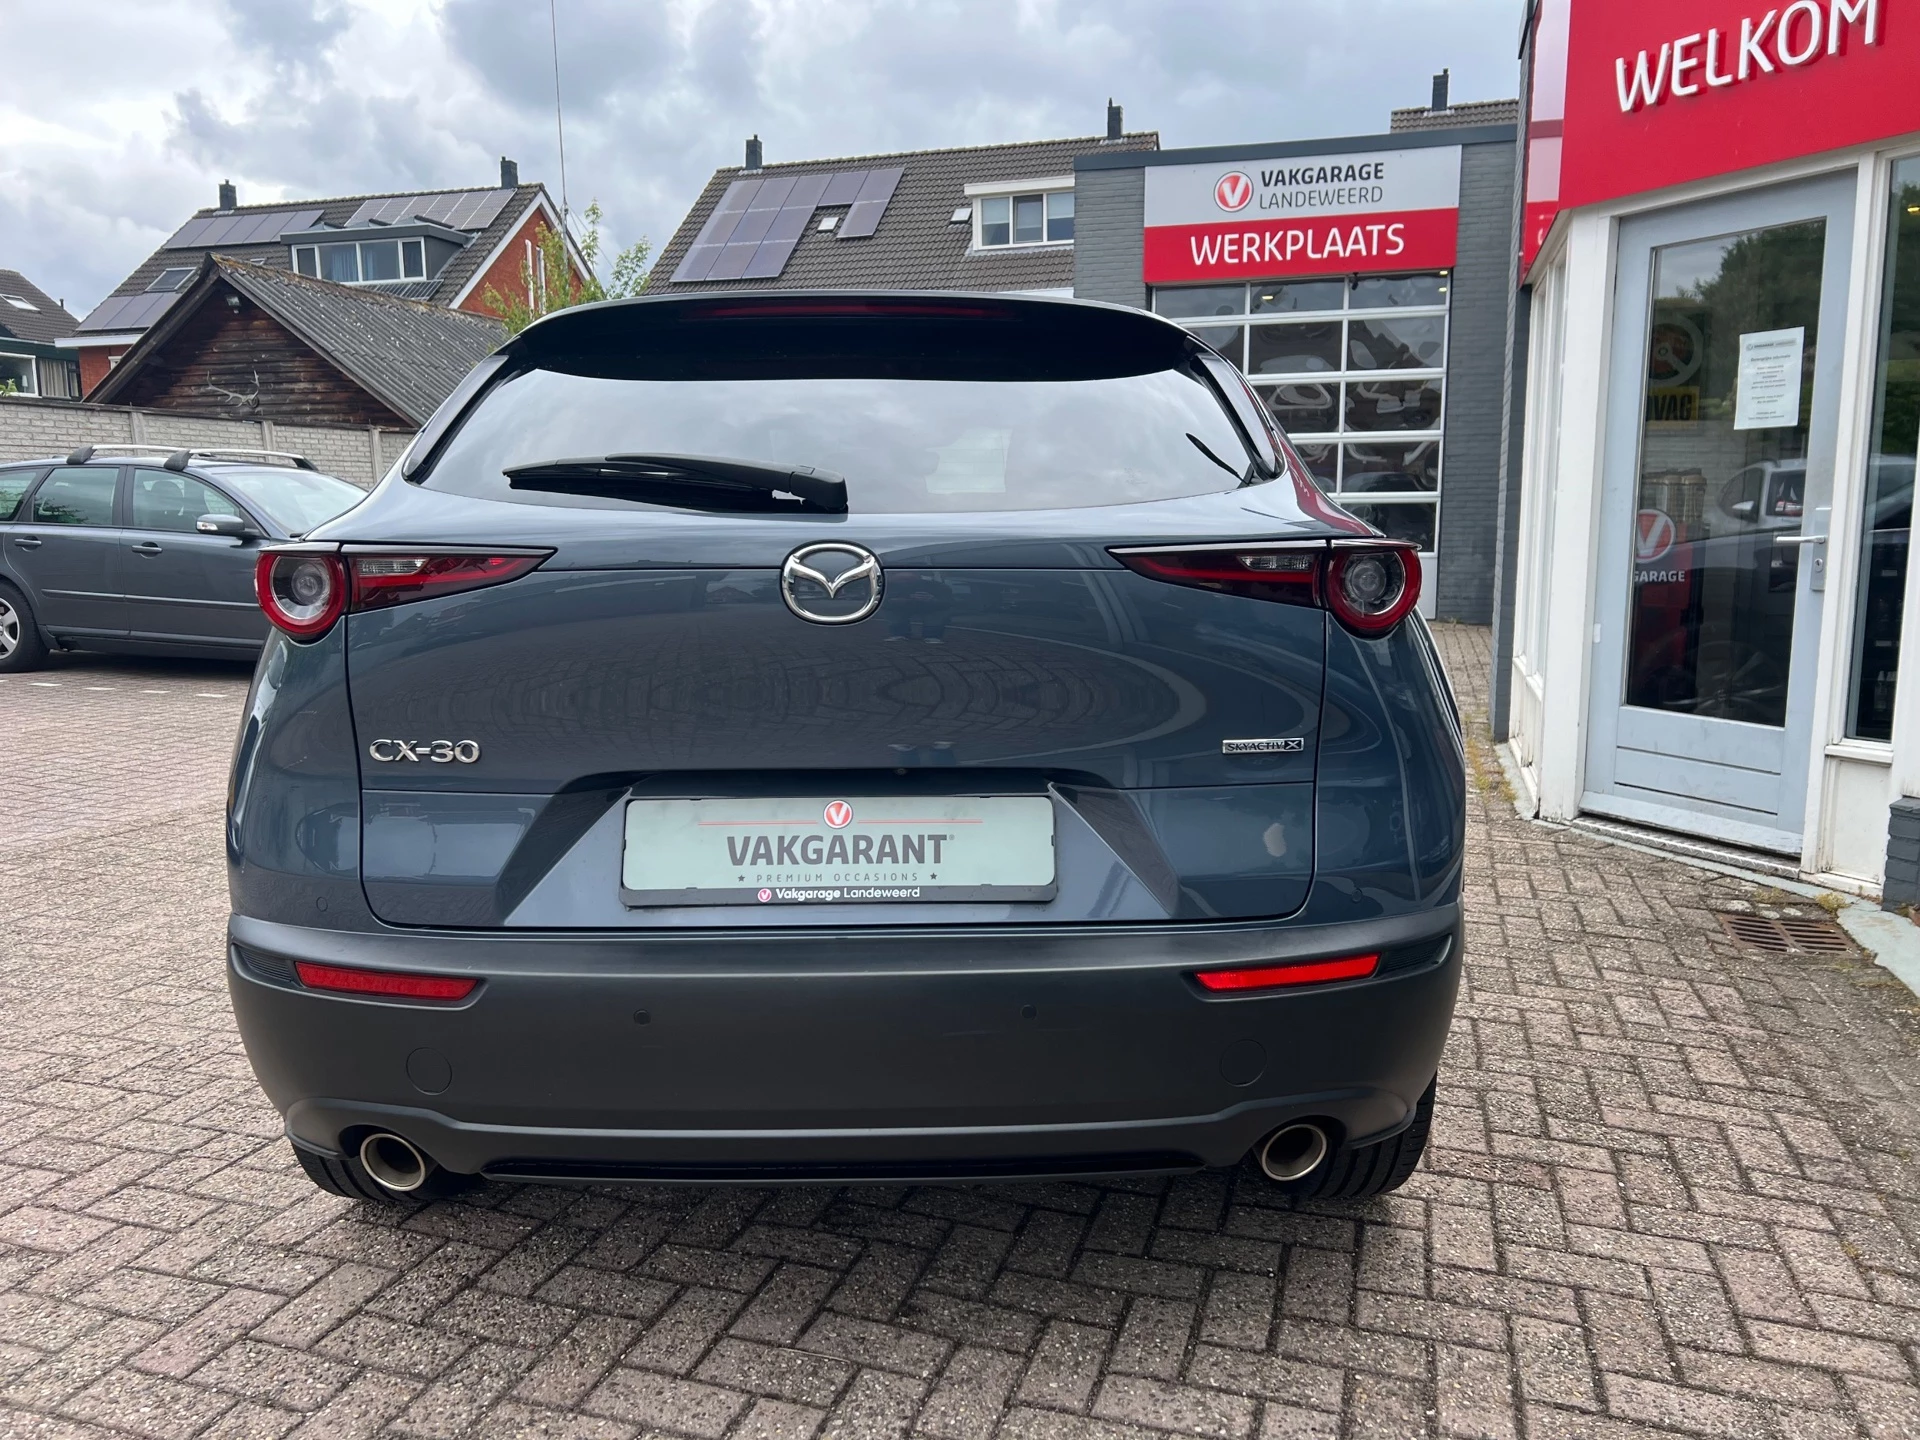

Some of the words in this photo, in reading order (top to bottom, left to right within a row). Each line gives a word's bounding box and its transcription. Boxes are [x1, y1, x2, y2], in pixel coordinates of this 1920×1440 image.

[1615, 0, 1878, 112] WELKOM
[1261, 162, 1384, 188] VAKGARAGE
[1259, 186, 1384, 210] LANDEWEERD
[1190, 223, 1405, 266] WERKPLAATS
[369, 739, 480, 764] CX-30
[756, 873, 823, 883] PREMIUM
[833, 872, 918, 882] OCCASIONS
[776, 888, 841, 901] Vakgarage
[844, 886, 920, 898] Landeweerd
